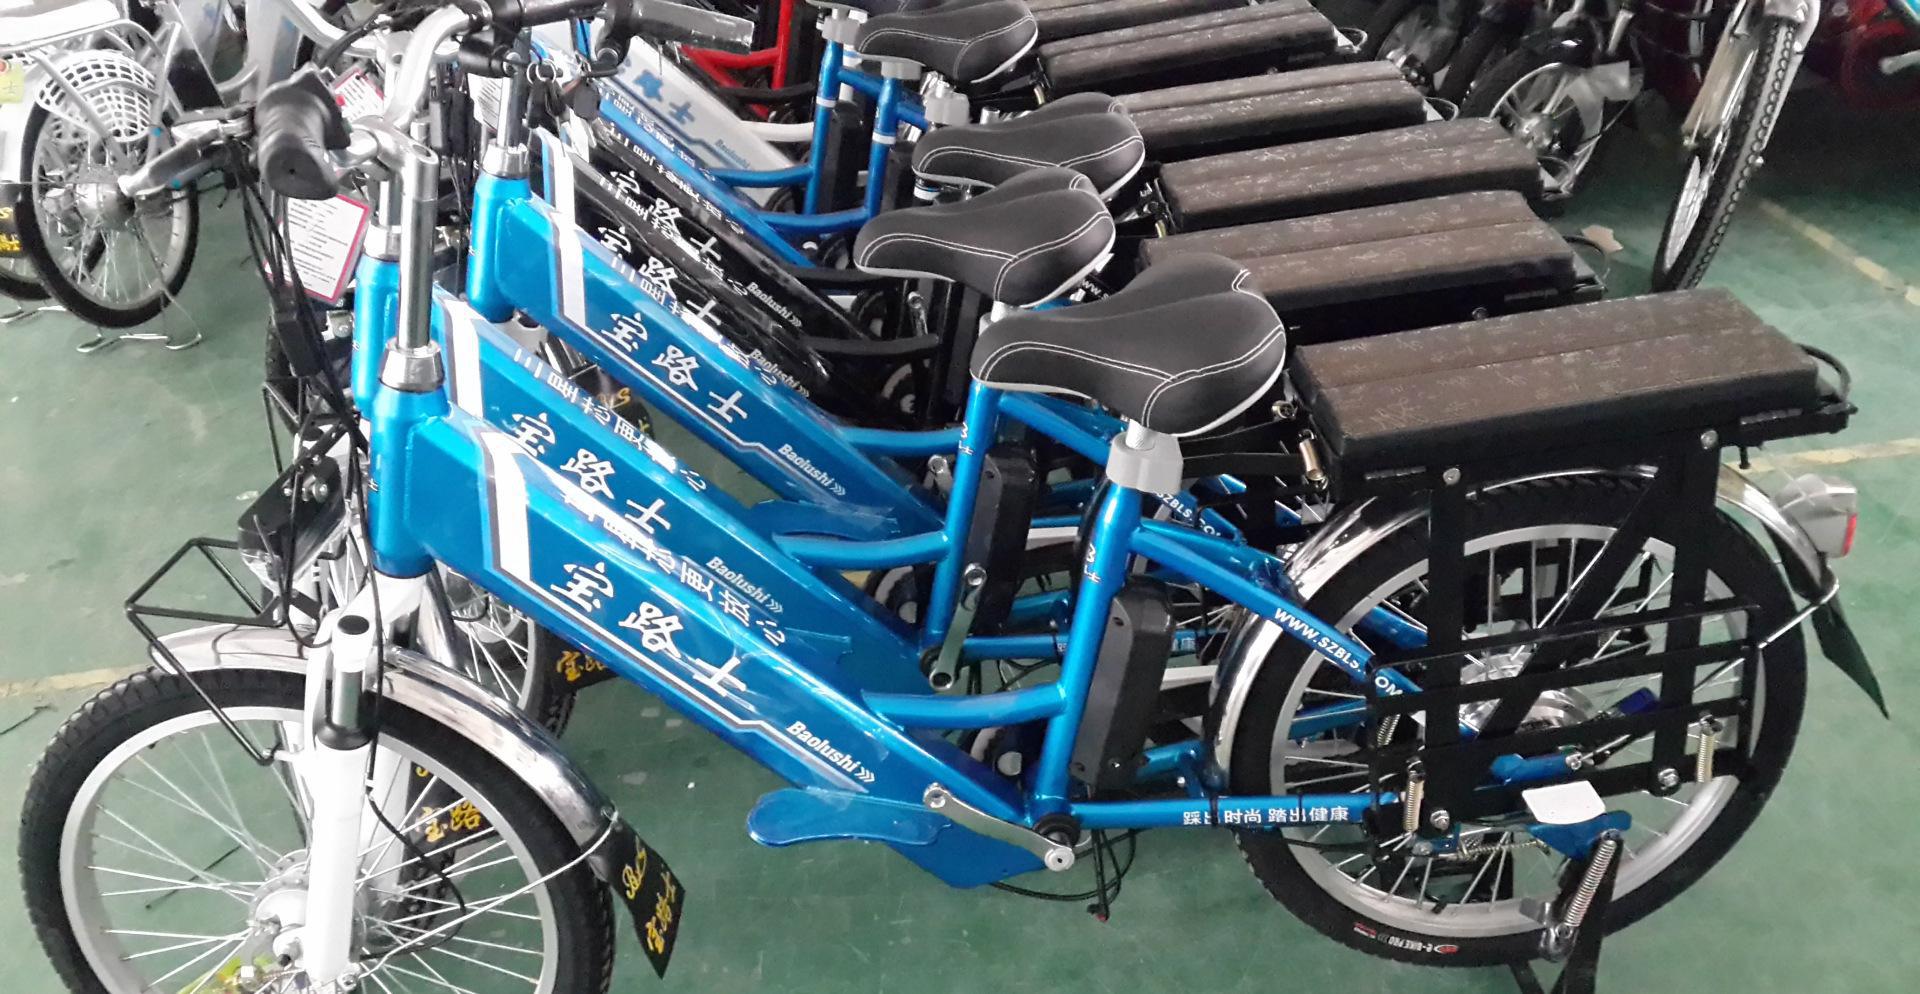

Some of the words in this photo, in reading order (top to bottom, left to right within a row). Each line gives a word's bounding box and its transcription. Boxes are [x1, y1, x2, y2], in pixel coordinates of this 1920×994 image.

[747, 281, 792, 320] Baolushi
[601, 311, 749, 424] 宝路士
[750, 348, 800, 390] Baolushi
[510, 412, 672, 534] 宝路士
[778, 443, 835, 487] Baolushi
[706, 556, 771, 605] Baolushi
[550, 561, 748, 698] 宝路士
[1274, 607, 1403, 696] WWW.SZBLS.OM
[786, 720, 862, 773] Baolushi
[1268, 805, 1349, 823] 踏出健康
